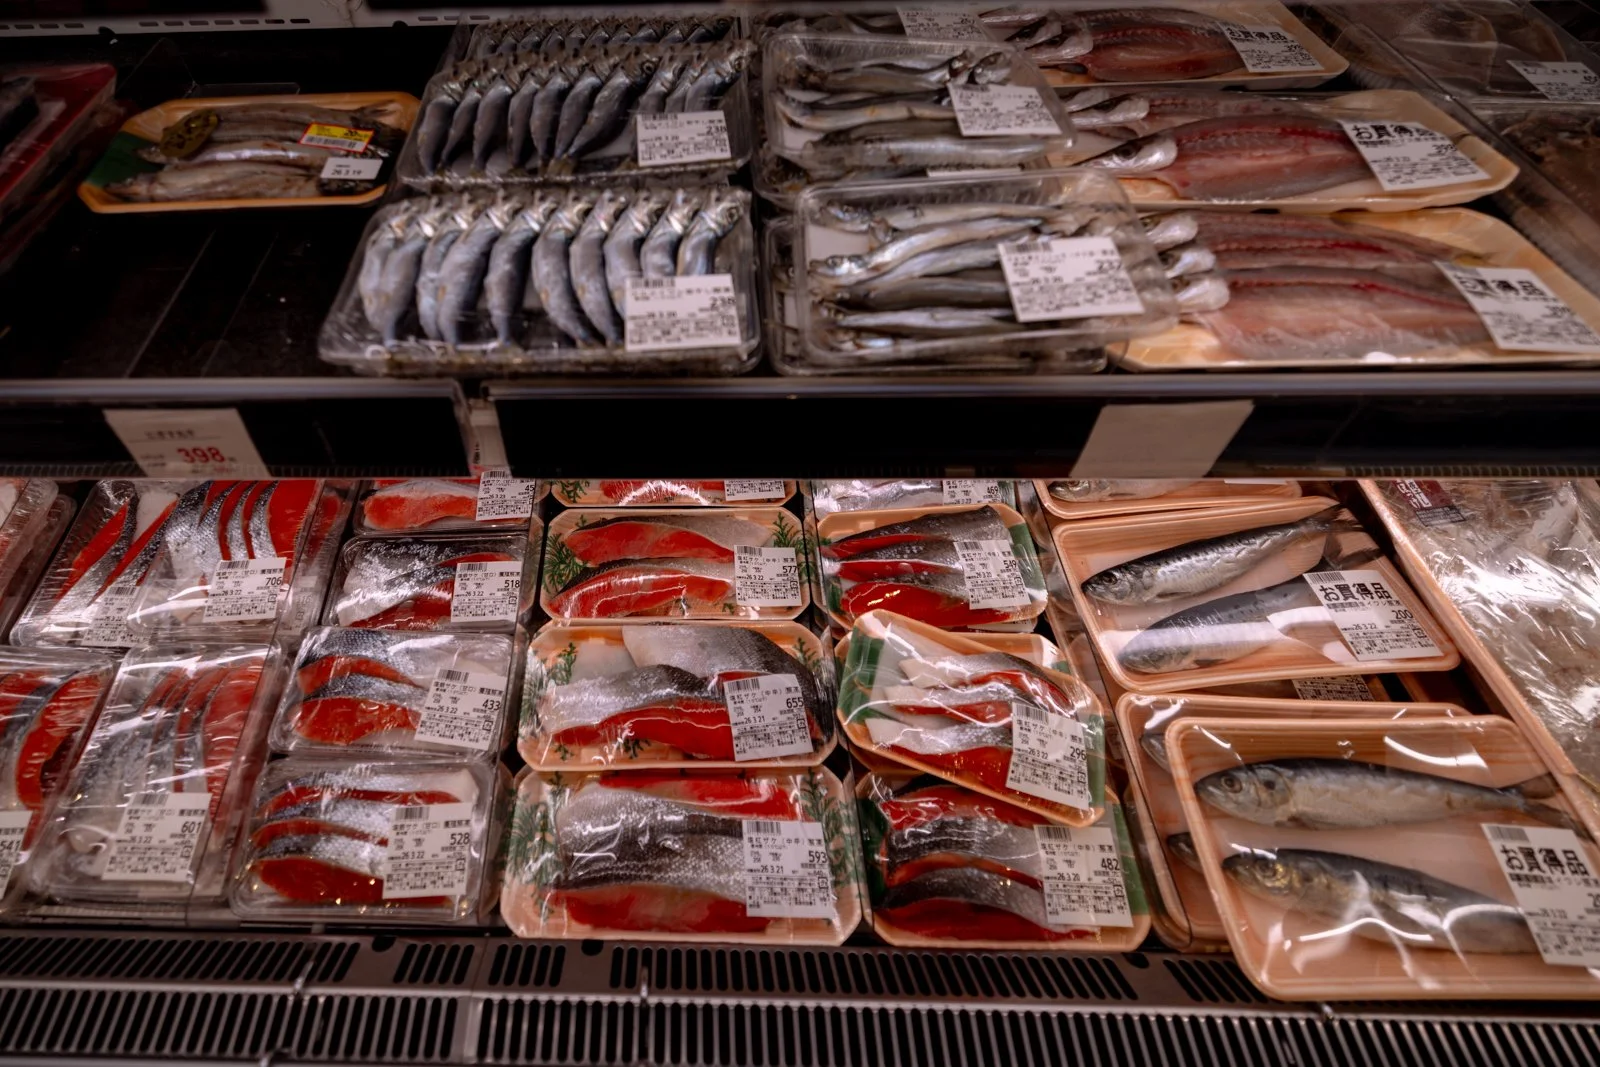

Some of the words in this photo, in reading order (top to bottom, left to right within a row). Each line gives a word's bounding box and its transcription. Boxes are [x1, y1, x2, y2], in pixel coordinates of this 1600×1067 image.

[1352, 124, 1437, 140] お買得品
[176, 447, 226, 464] 398
[524, 484, 536, 492] 45
[782, 565, 797, 574] 577
[265, 577, 283, 586] 706
[504, 579, 521, 589] 518
[1319, 582, 1393, 602] お買得品
[1391, 609, 1414, 620] 200
[482, 699, 502, 711] 433
[785, 697, 804, 709] 655
[1069, 745, 1087, 761] 296
[181, 821, 202, 834] 601
[450, 832, 471, 846] 528
[808, 849, 828, 864] 593
[1500, 844, 1590, 877] お買得品
[1100, 857, 1121, 871] 482
